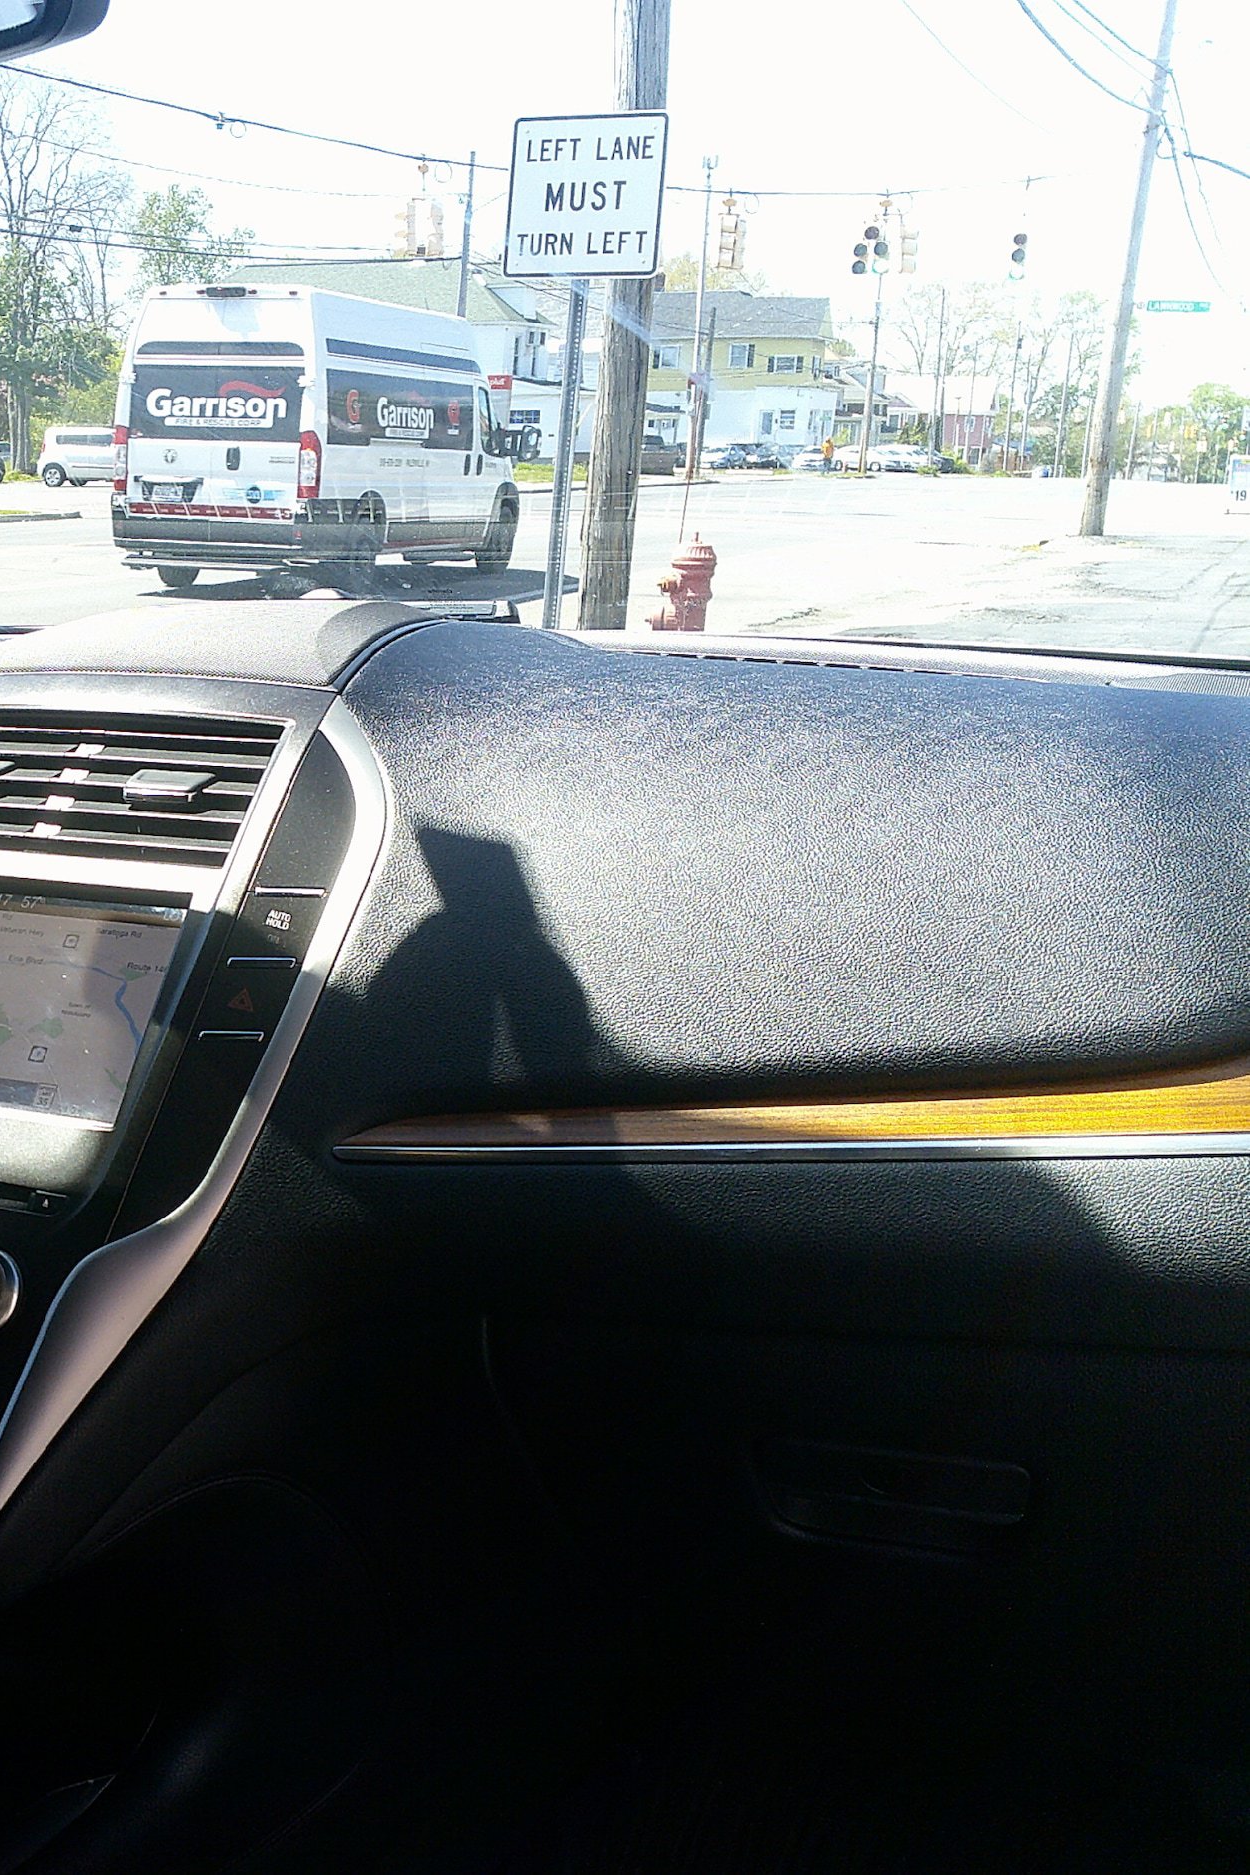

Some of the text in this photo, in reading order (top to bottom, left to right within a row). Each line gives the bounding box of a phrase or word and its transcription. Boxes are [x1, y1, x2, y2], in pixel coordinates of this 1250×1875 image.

[526, 135, 655, 163] LEFT LANE
[544, 180, 627, 212] MUST
[517, 230, 648, 256] TURN LEFT
[146, 387, 288, 418] Garrison
[376, 396, 435, 430] Garrison
[265, 917, 290, 931] HOLD
[267, 909, 292, 923] AUTO
[130, 930, 143, 939] Rd
[126, 961, 152, 972] Route
